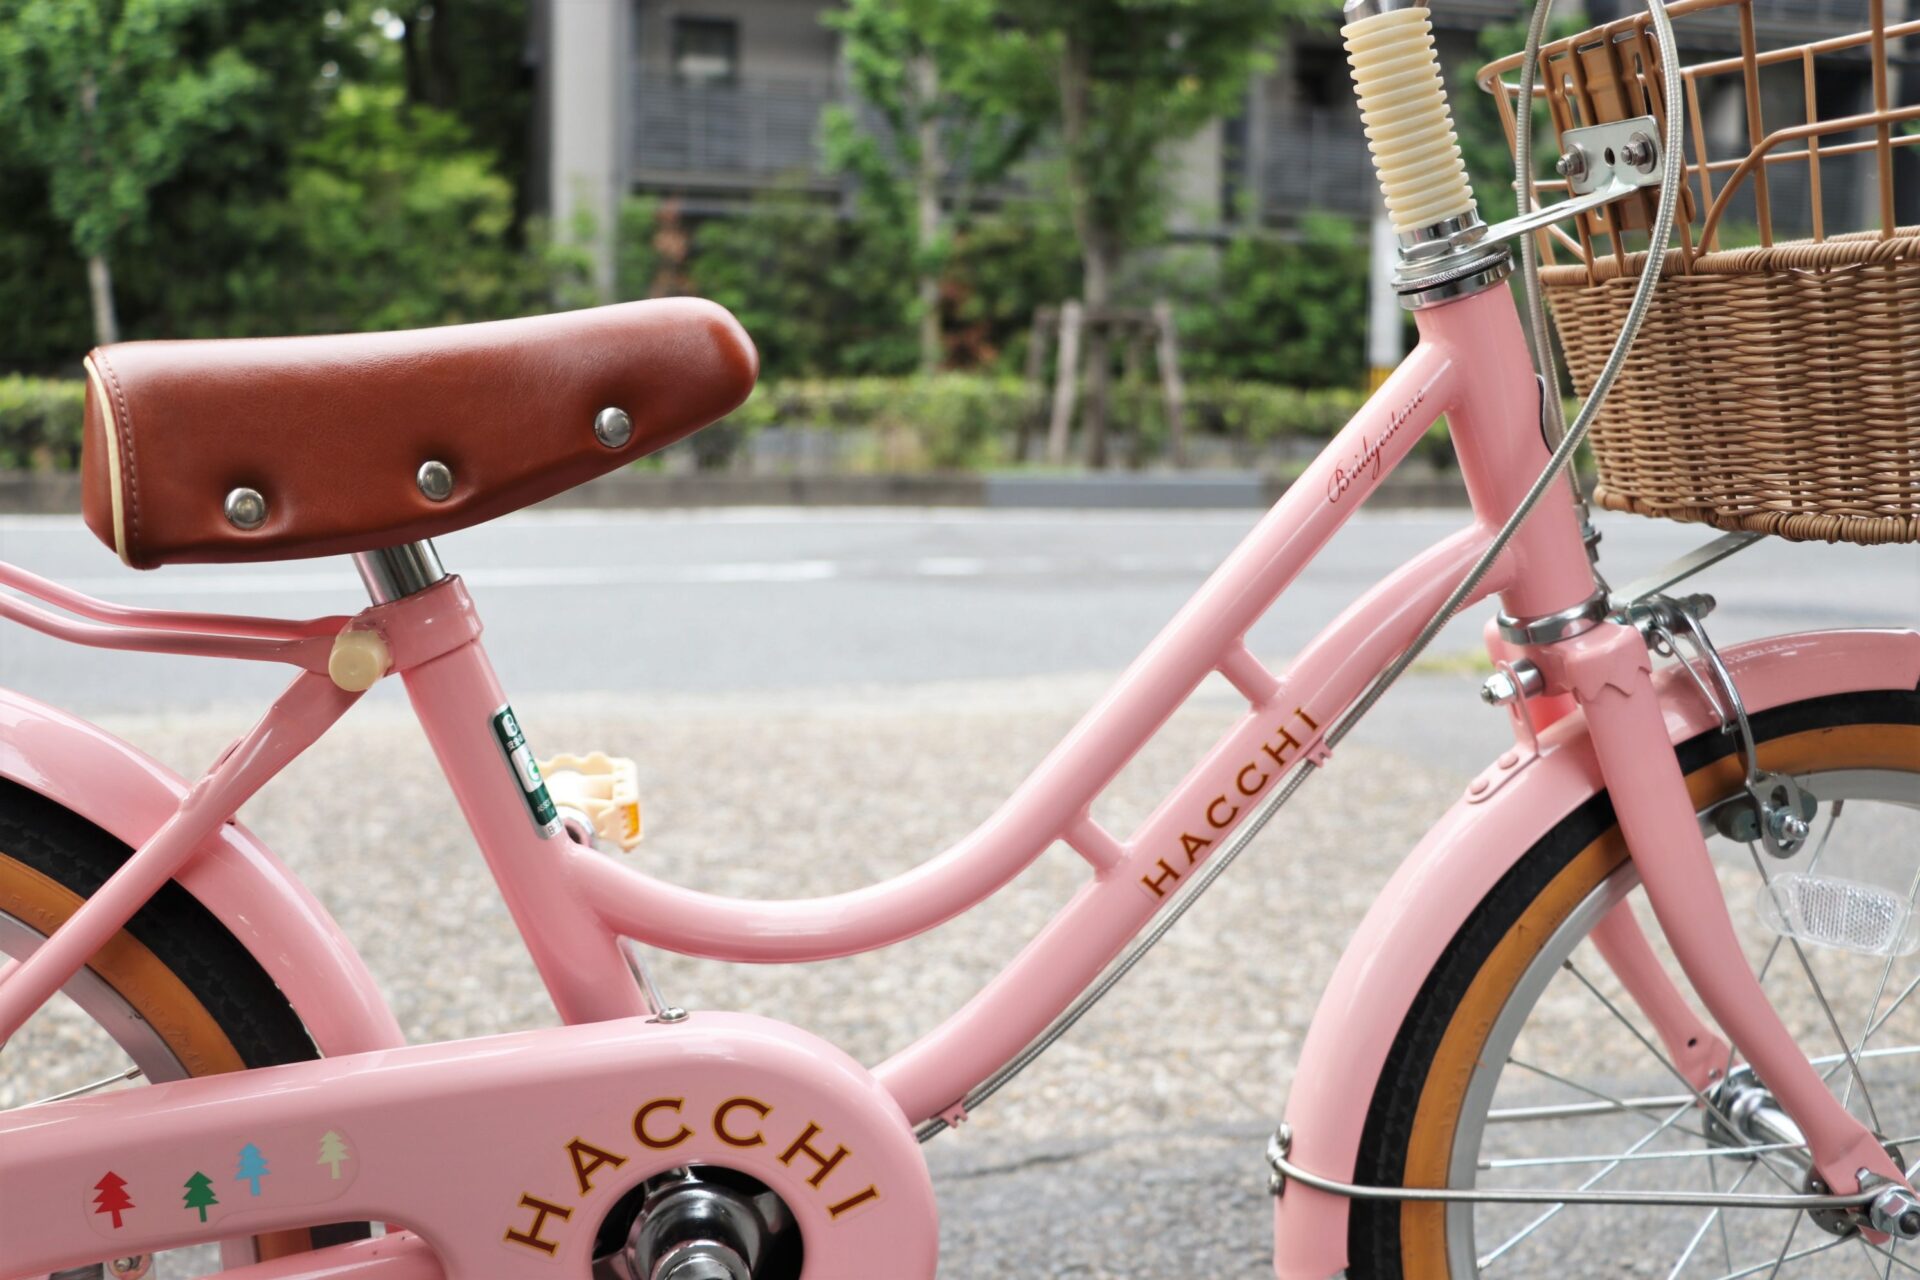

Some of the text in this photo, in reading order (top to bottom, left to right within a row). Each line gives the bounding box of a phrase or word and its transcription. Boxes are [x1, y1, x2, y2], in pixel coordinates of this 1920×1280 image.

[1328, 390, 1424, 503] Bridgestone
[1141, 707, 1319, 898] HACCHI
[504, 1096, 881, 1257] HACCHI
